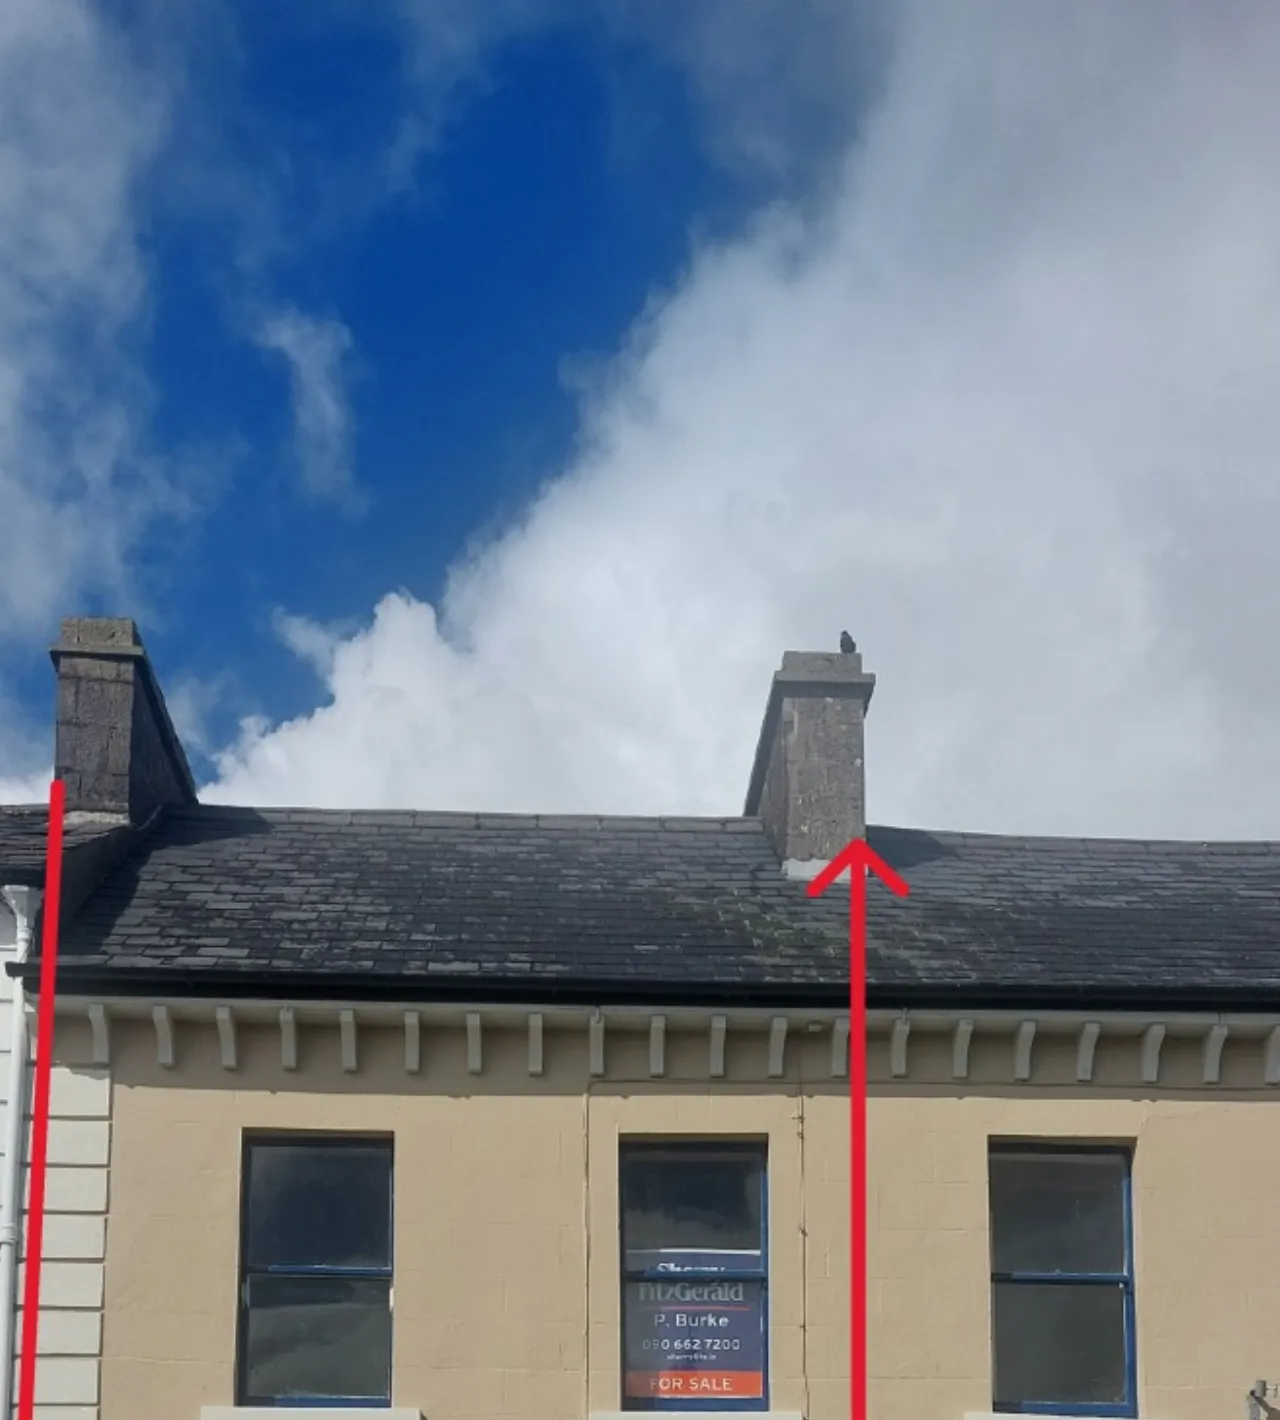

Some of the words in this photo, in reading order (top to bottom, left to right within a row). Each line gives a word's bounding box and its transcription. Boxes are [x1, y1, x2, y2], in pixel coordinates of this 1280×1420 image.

[654, 1313, 670, 1327] P.
[676, 1313, 729, 1327] Burke
[674, 1339, 701, 1350] 662
[704, 1339, 740, 1350] 7200
[650, 1378, 683, 1391] FOR
[689, 1378, 733, 1391] SALE
